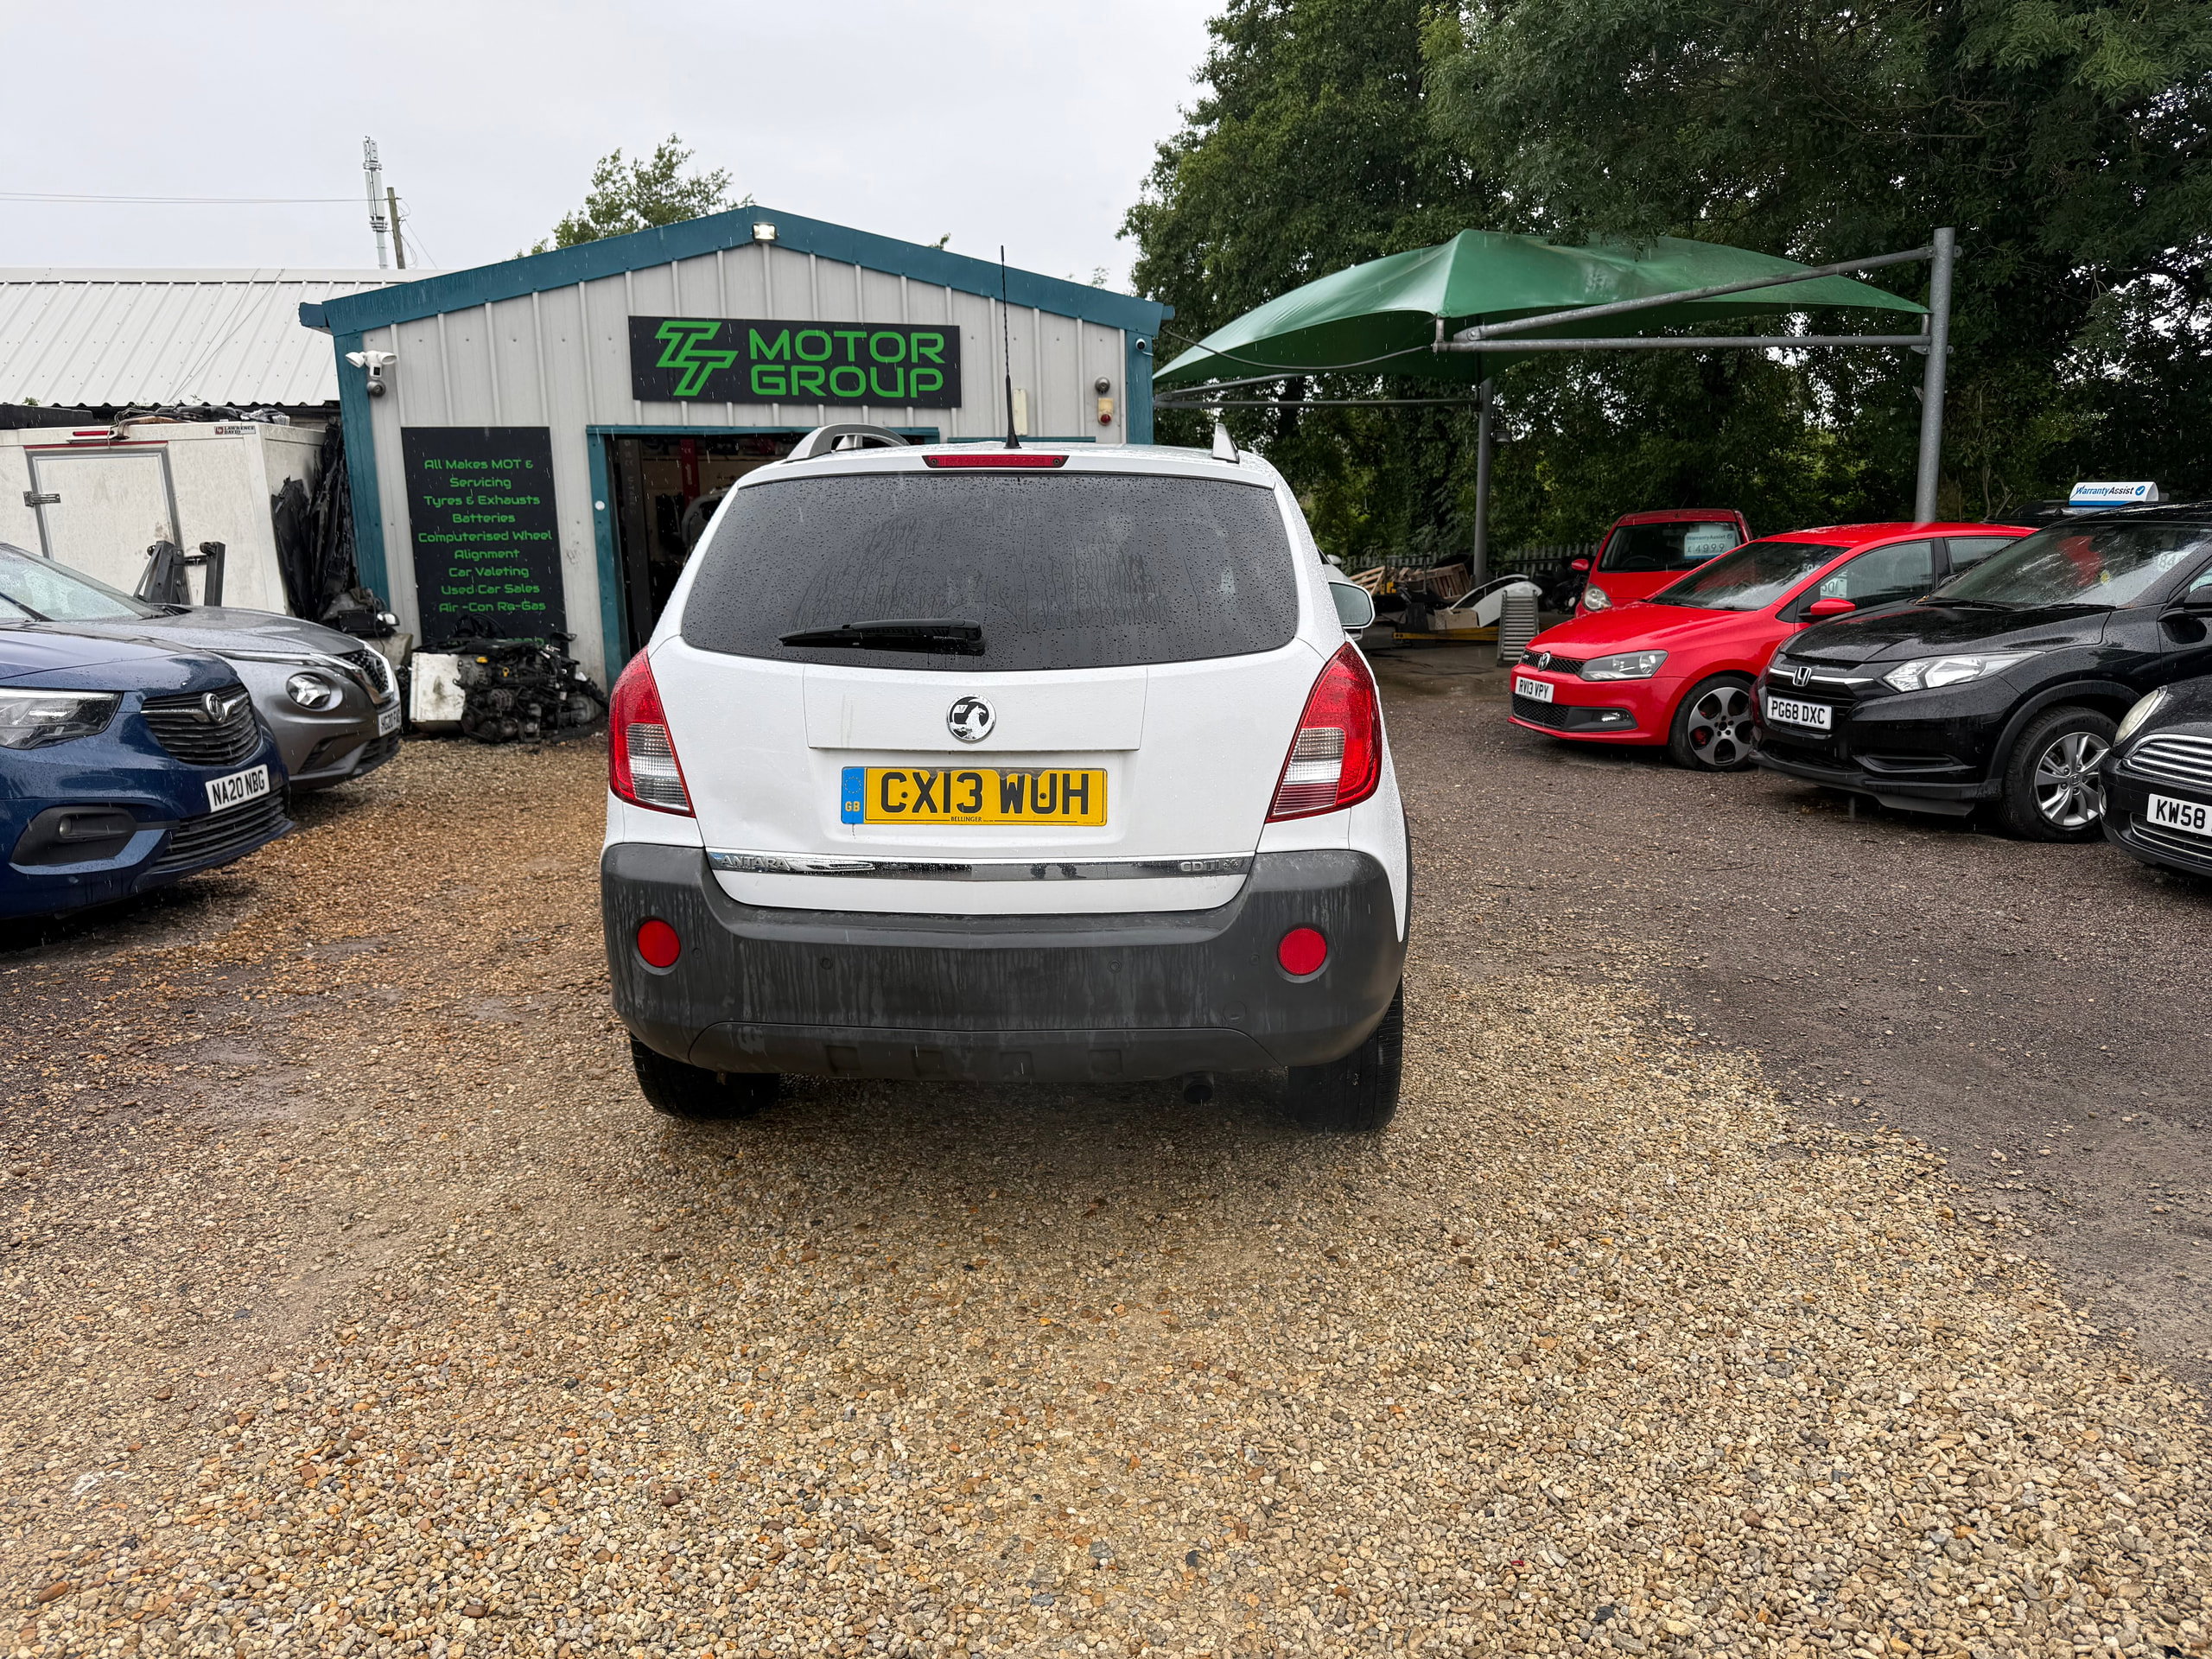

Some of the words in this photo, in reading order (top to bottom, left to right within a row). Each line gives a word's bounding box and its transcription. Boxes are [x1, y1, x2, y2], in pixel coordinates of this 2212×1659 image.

[748, 328, 945, 364] MOTOR
[749, 364, 944, 398] GROUP
[423, 459, 442, 469] All
[445, 459, 488, 469] Makes
[491, 459, 522, 469] MOT
[524, 460, 534, 468] &
[449, 476, 512, 490] Servicing
[2075, 485, 2134, 497] WarrantyAssist
[423, 495, 463, 508] Tyres
[467, 496, 474, 505] &
[477, 494, 541, 505] Exhausts
[452, 512, 516, 524] Batteries
[418, 531, 510, 543] Computerised
[512, 530, 553, 541] Wheel
[454, 549, 520, 562] Alignment
[448, 567, 472, 577] Car
[475, 566, 530, 579] Valeting
[441, 584, 475, 595] Used
[478, 585, 502, 594] Car
[504, 583, 541, 594] Sales
[439, 602, 459, 613] Air
[497, 601, 547, 612] Re-Gas
[1518, 679, 1534, 696] RV13
[1770, 700, 1799, 721] PG68
[1802, 705, 1826, 725] DXC
[212, 776, 245, 806] NA20
[245, 769, 265, 796] NBG
[880, 772, 983, 814] CX13
[999, 772, 1090, 815] WUH
[844, 801, 861, 812] GB
[2155, 798, 2206, 830] KW58
[721, 855, 792, 871] ANTARA
